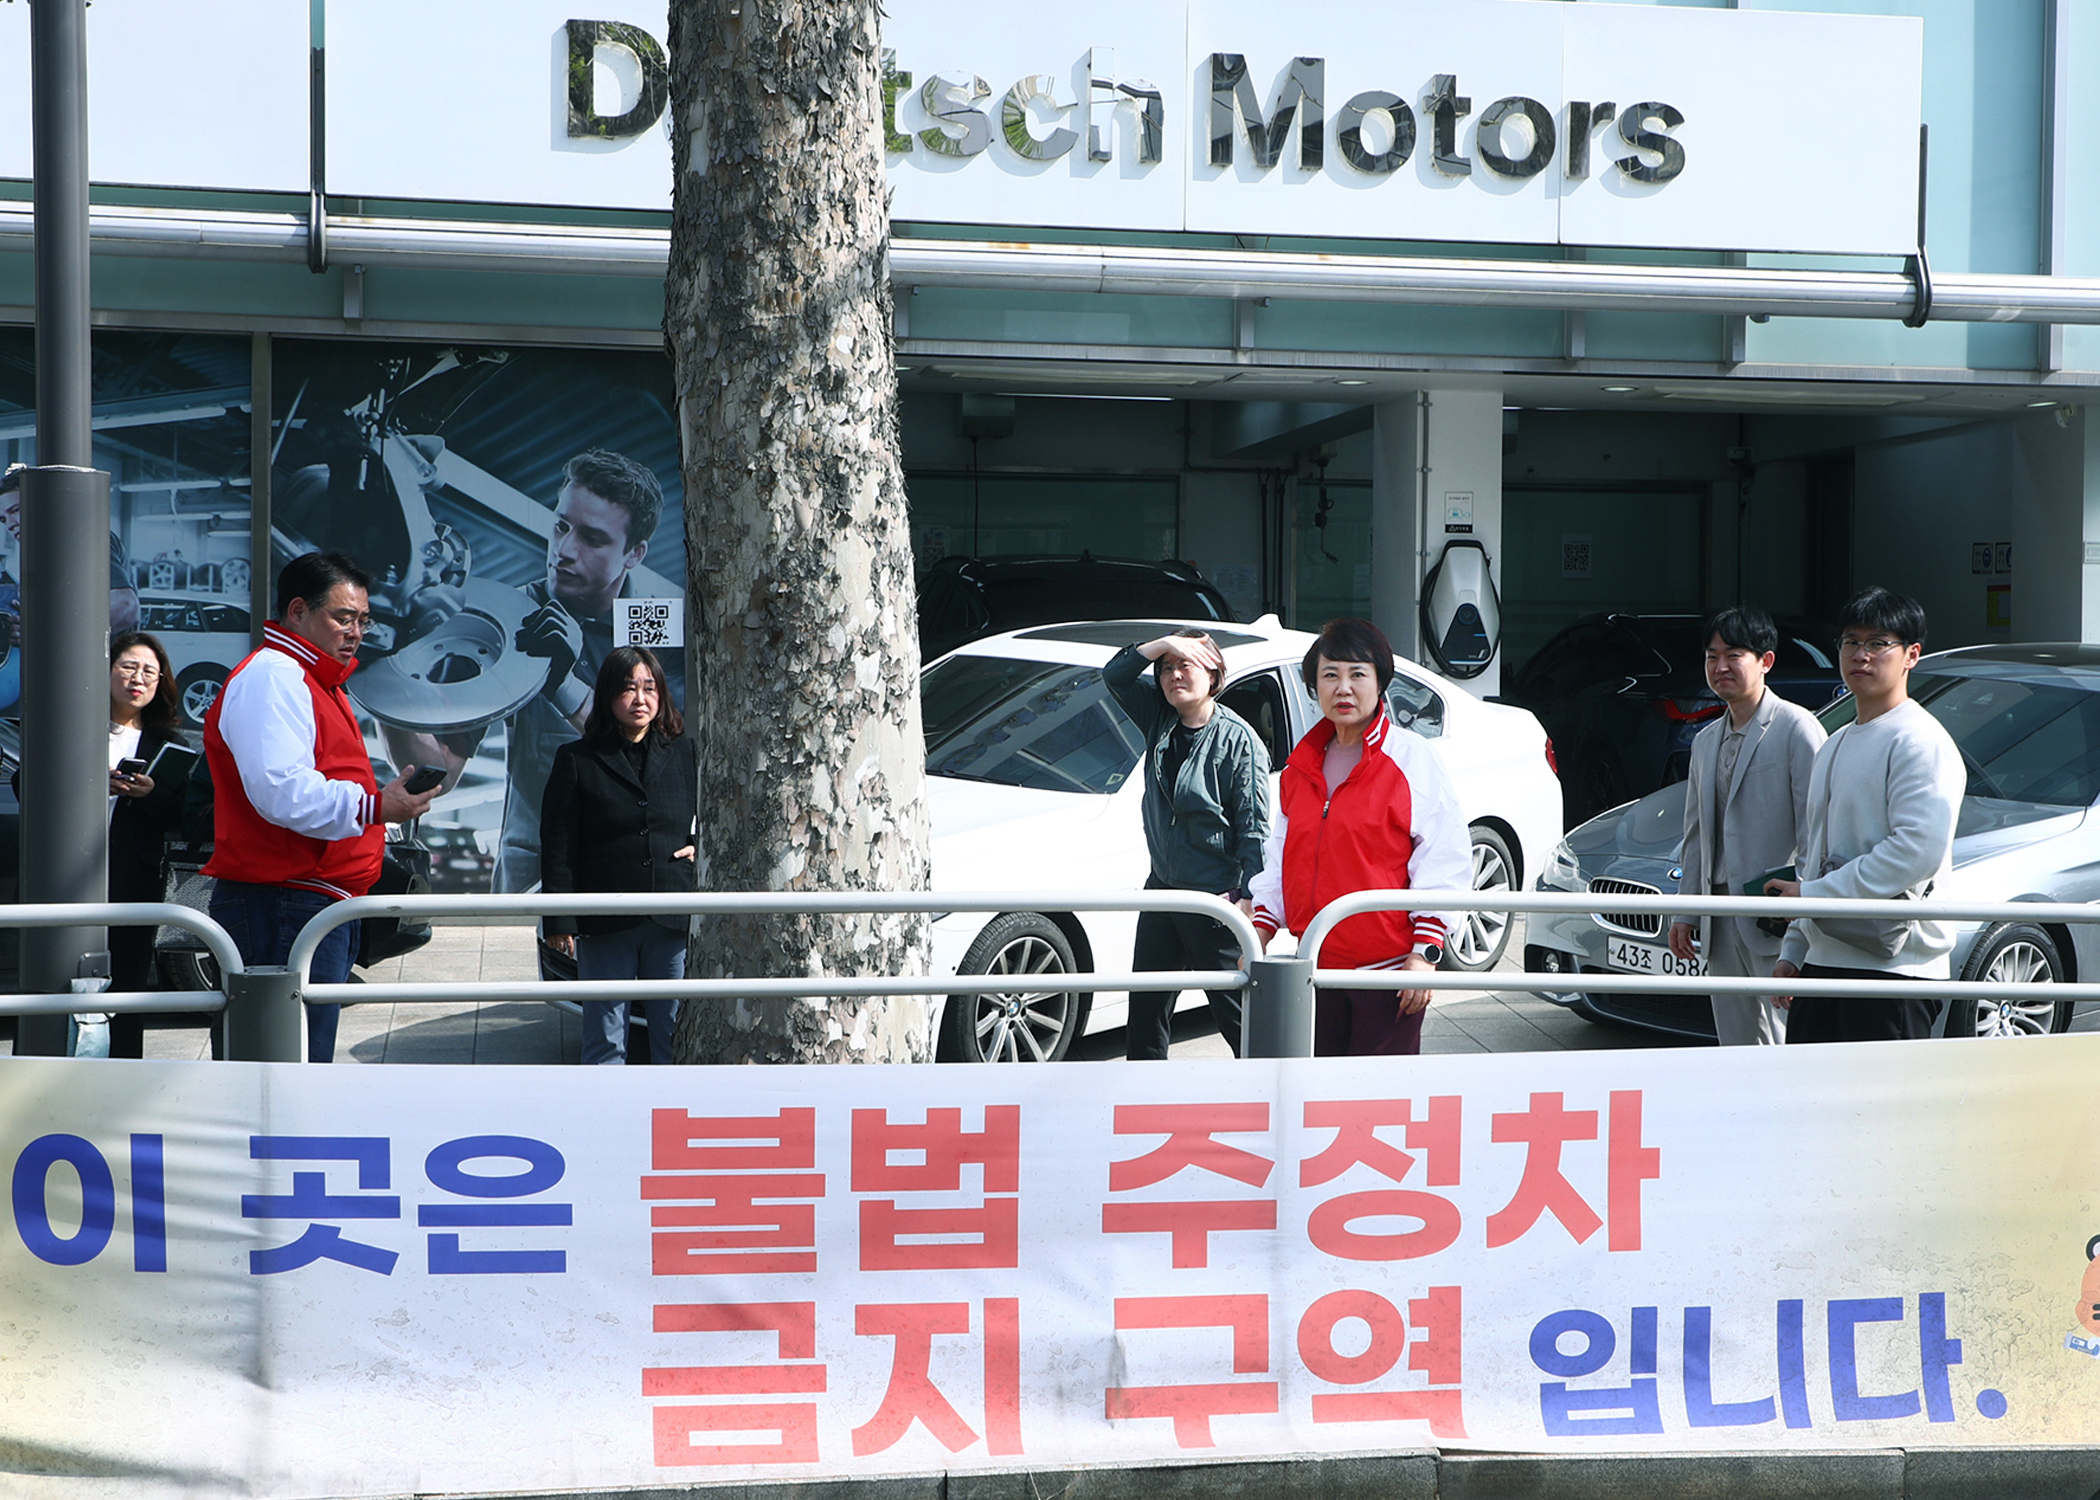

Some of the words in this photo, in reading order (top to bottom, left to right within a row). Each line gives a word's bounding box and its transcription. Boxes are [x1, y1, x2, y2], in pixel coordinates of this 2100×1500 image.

[567, 19, 1164, 164] Dtsch
[1209, 53, 1686, 184] Motors
[1617, 943, 1652, 970] 43조
[13, 1133, 167, 1273] 이
[241, 1135, 573, 1276] 곳은
[640, 1105, 1021, 1276] 불법
[1102, 1090, 1661, 1269] 주정차
[642, 1297, 1025, 1468] 금지
[1104, 1286, 1469, 1449] 구역
[1528, 1292, 2008, 1437] 입니다.
